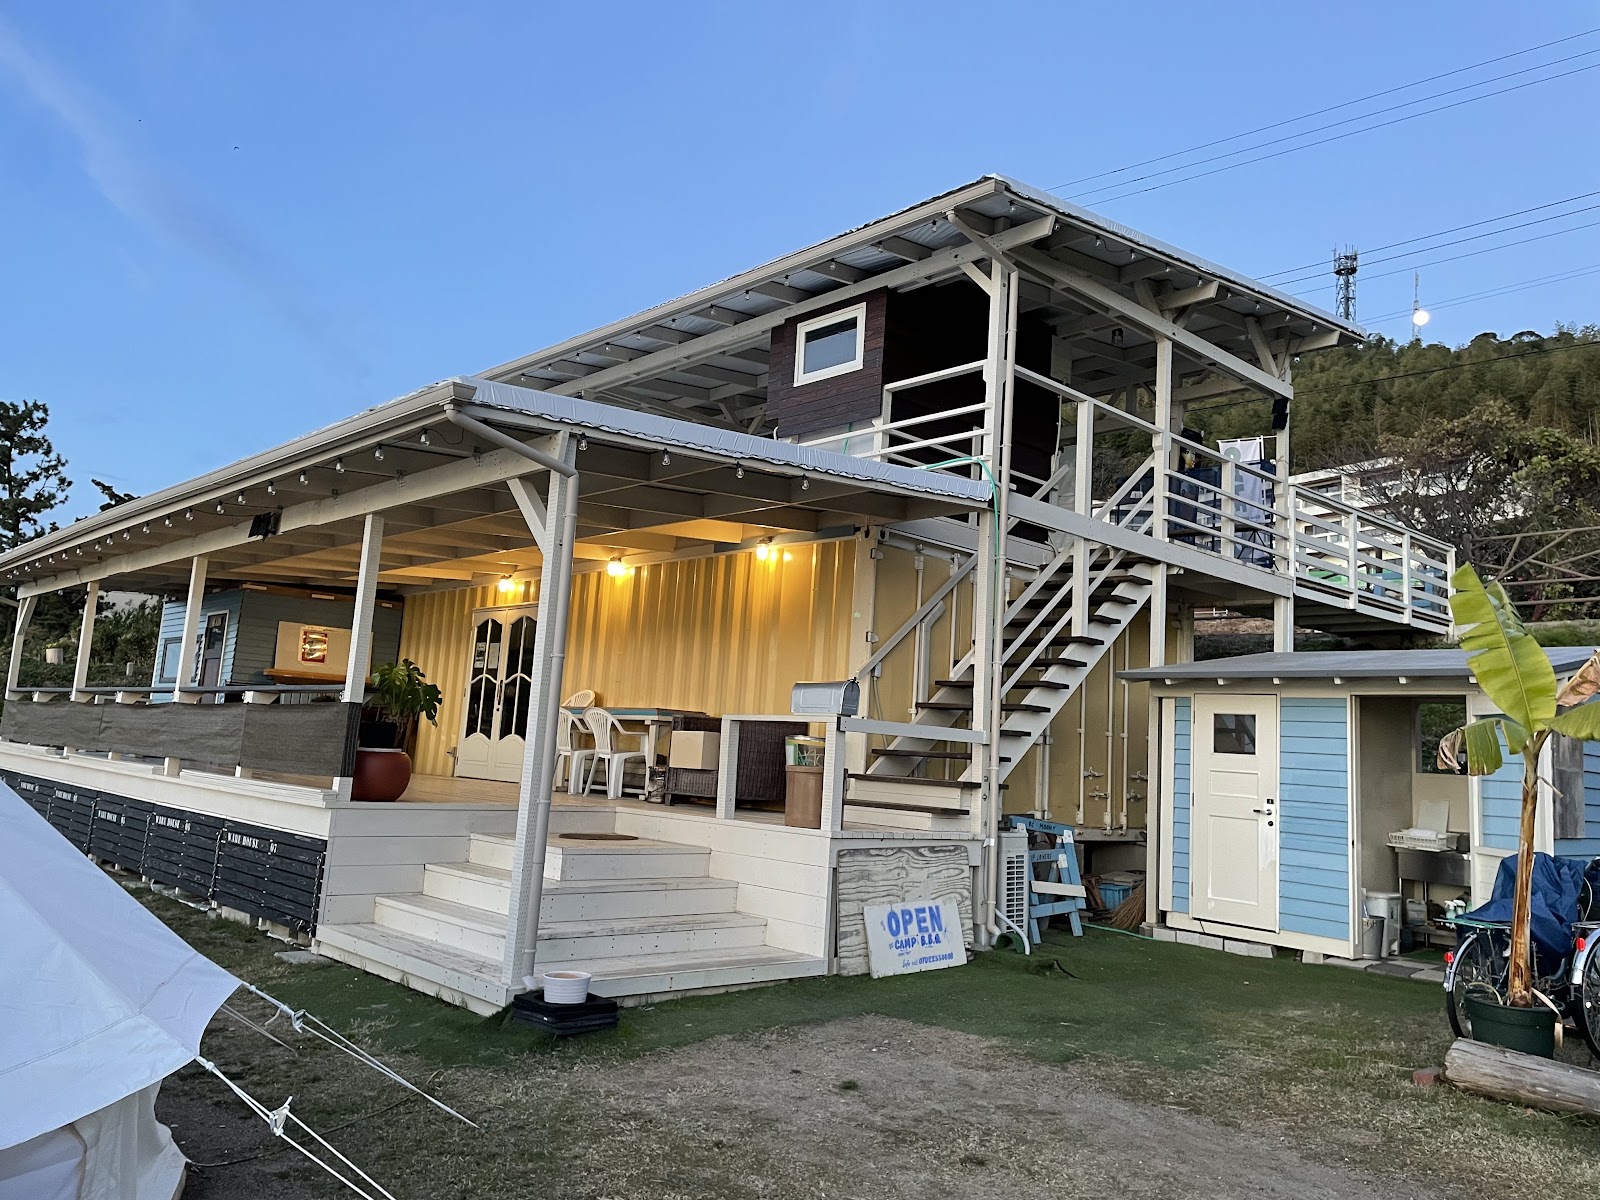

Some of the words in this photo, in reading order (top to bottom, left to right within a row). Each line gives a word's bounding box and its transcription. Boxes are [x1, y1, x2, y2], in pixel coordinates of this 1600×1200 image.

[156, 815, 167, 825] WARE
[228, 832, 241, 845] WARE
[242, 836, 259, 849] HOUSE
[887, 905, 943, 937] OPEN
[894, 937, 917, 950] CAMP
